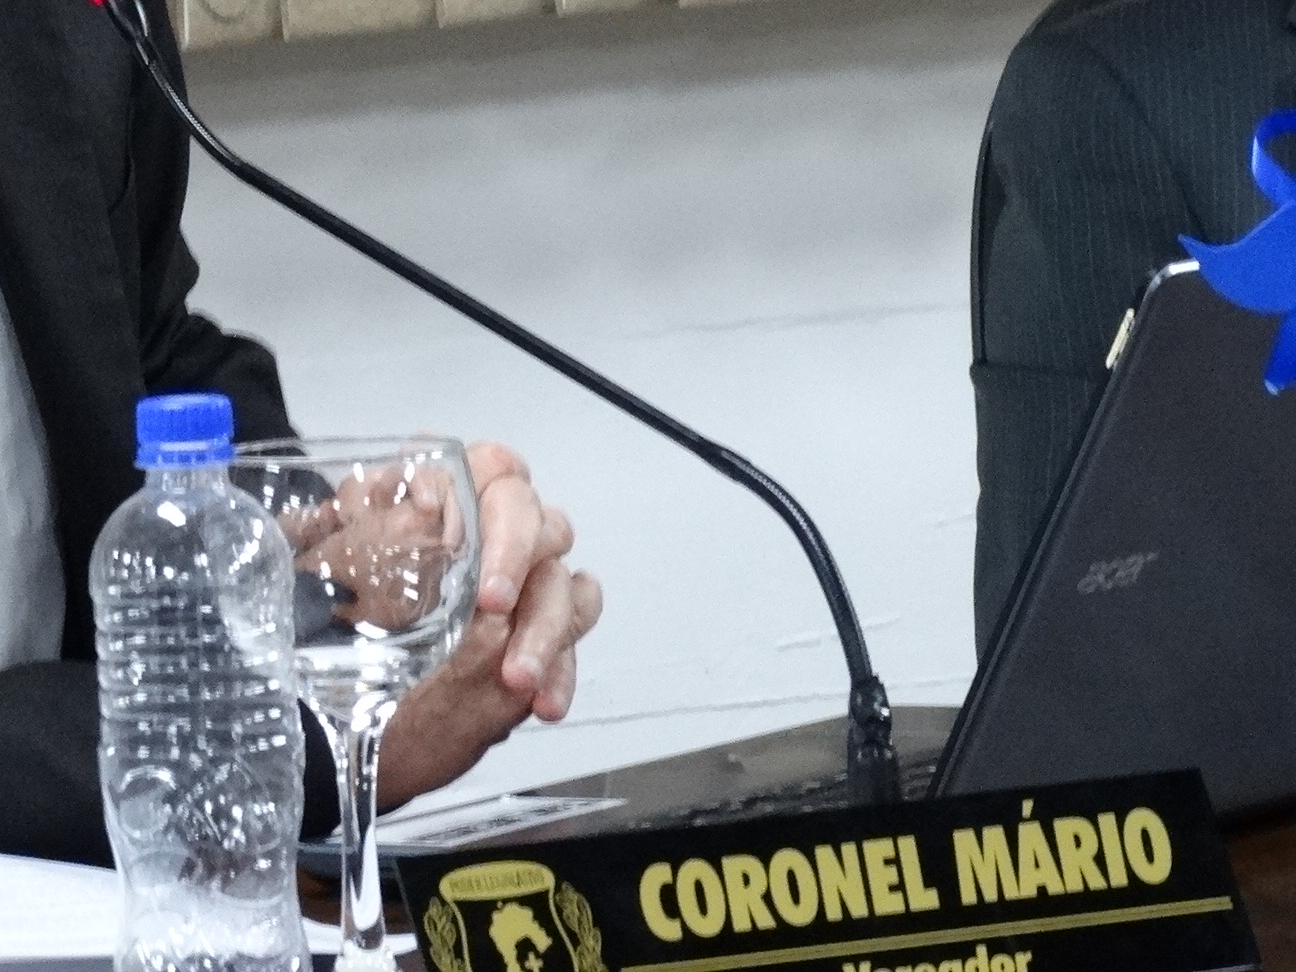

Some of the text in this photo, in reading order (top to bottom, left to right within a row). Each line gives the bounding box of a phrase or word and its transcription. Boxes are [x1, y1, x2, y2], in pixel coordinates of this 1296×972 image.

[1076, 551, 1160, 595] acer
[639, 798, 1172, 942] CORONEL MÁRIO
